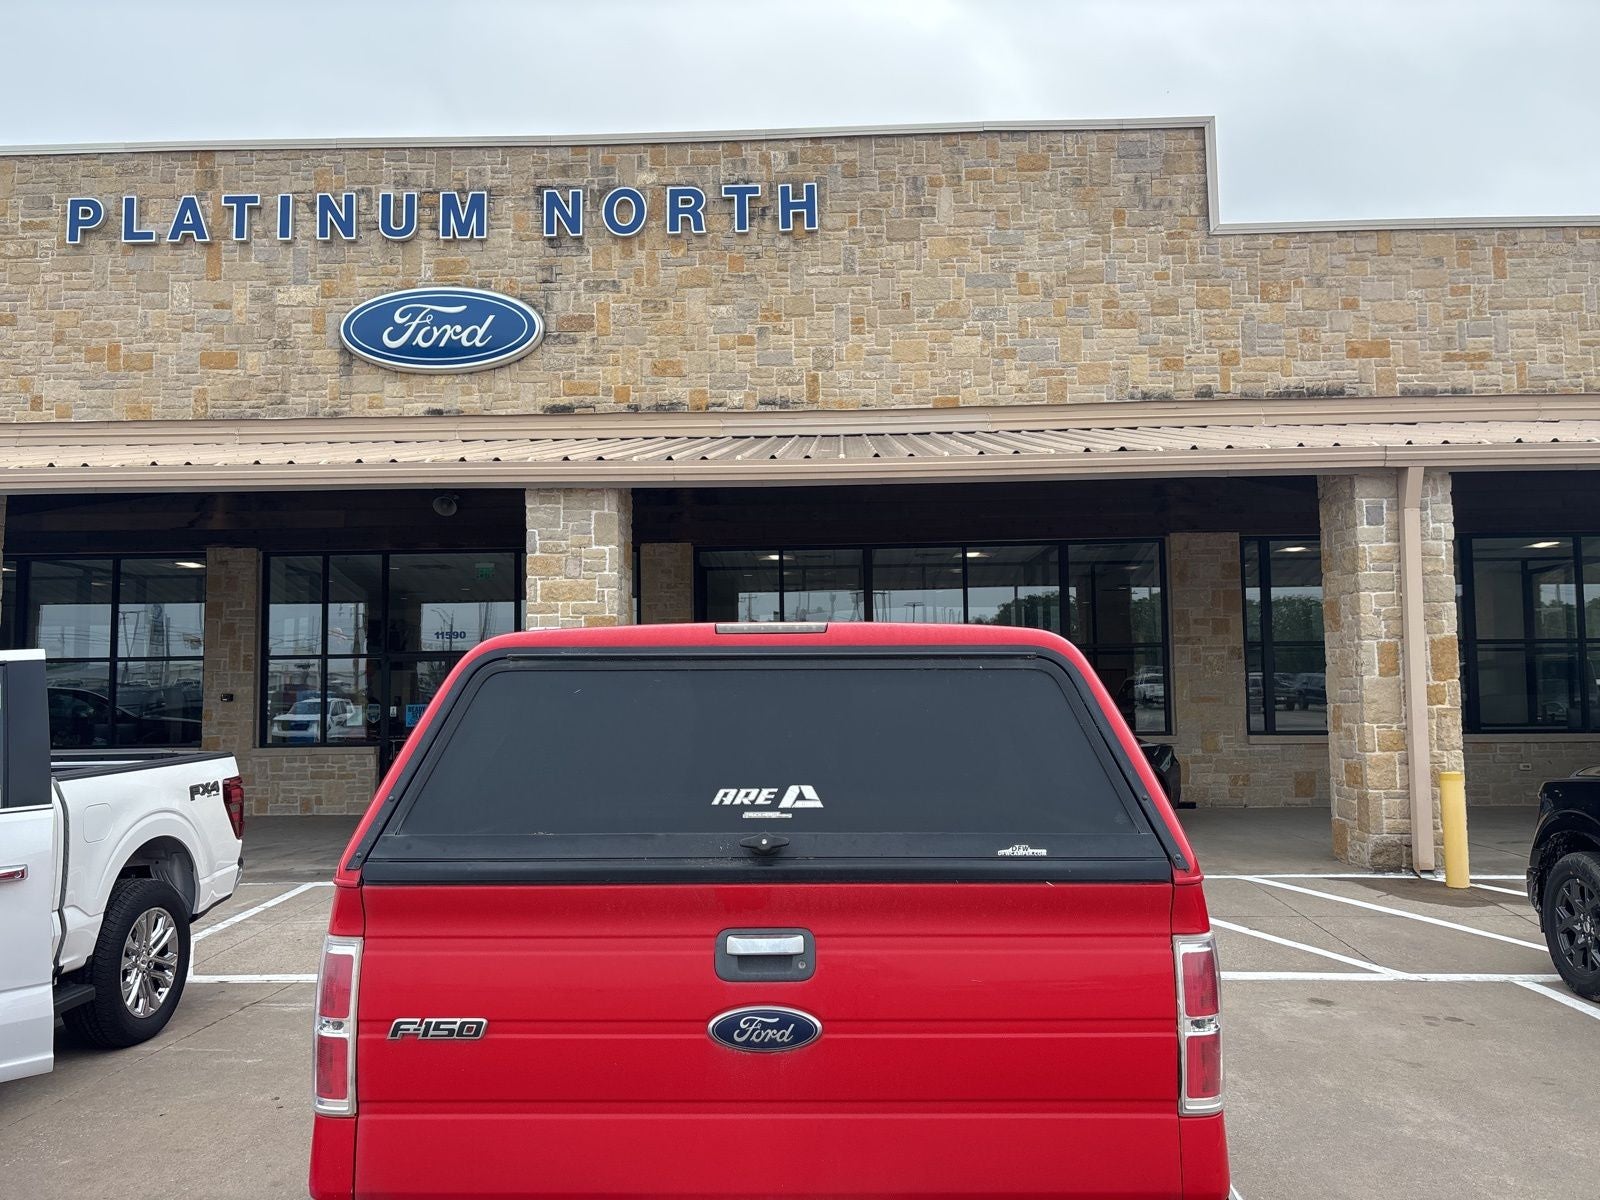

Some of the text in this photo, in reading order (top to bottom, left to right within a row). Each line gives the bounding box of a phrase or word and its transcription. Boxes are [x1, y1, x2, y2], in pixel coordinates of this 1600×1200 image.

[66, 182, 819, 245] PLATINUM NORTH
[381, 303, 494, 350] Ford
[434, 631, 466, 640] 11590
[189, 780, 220, 801] FX4
[711, 788, 778, 805] ARE
[387, 1017, 488, 1040] F-150
[733, 1016, 795, 1042] Ford
